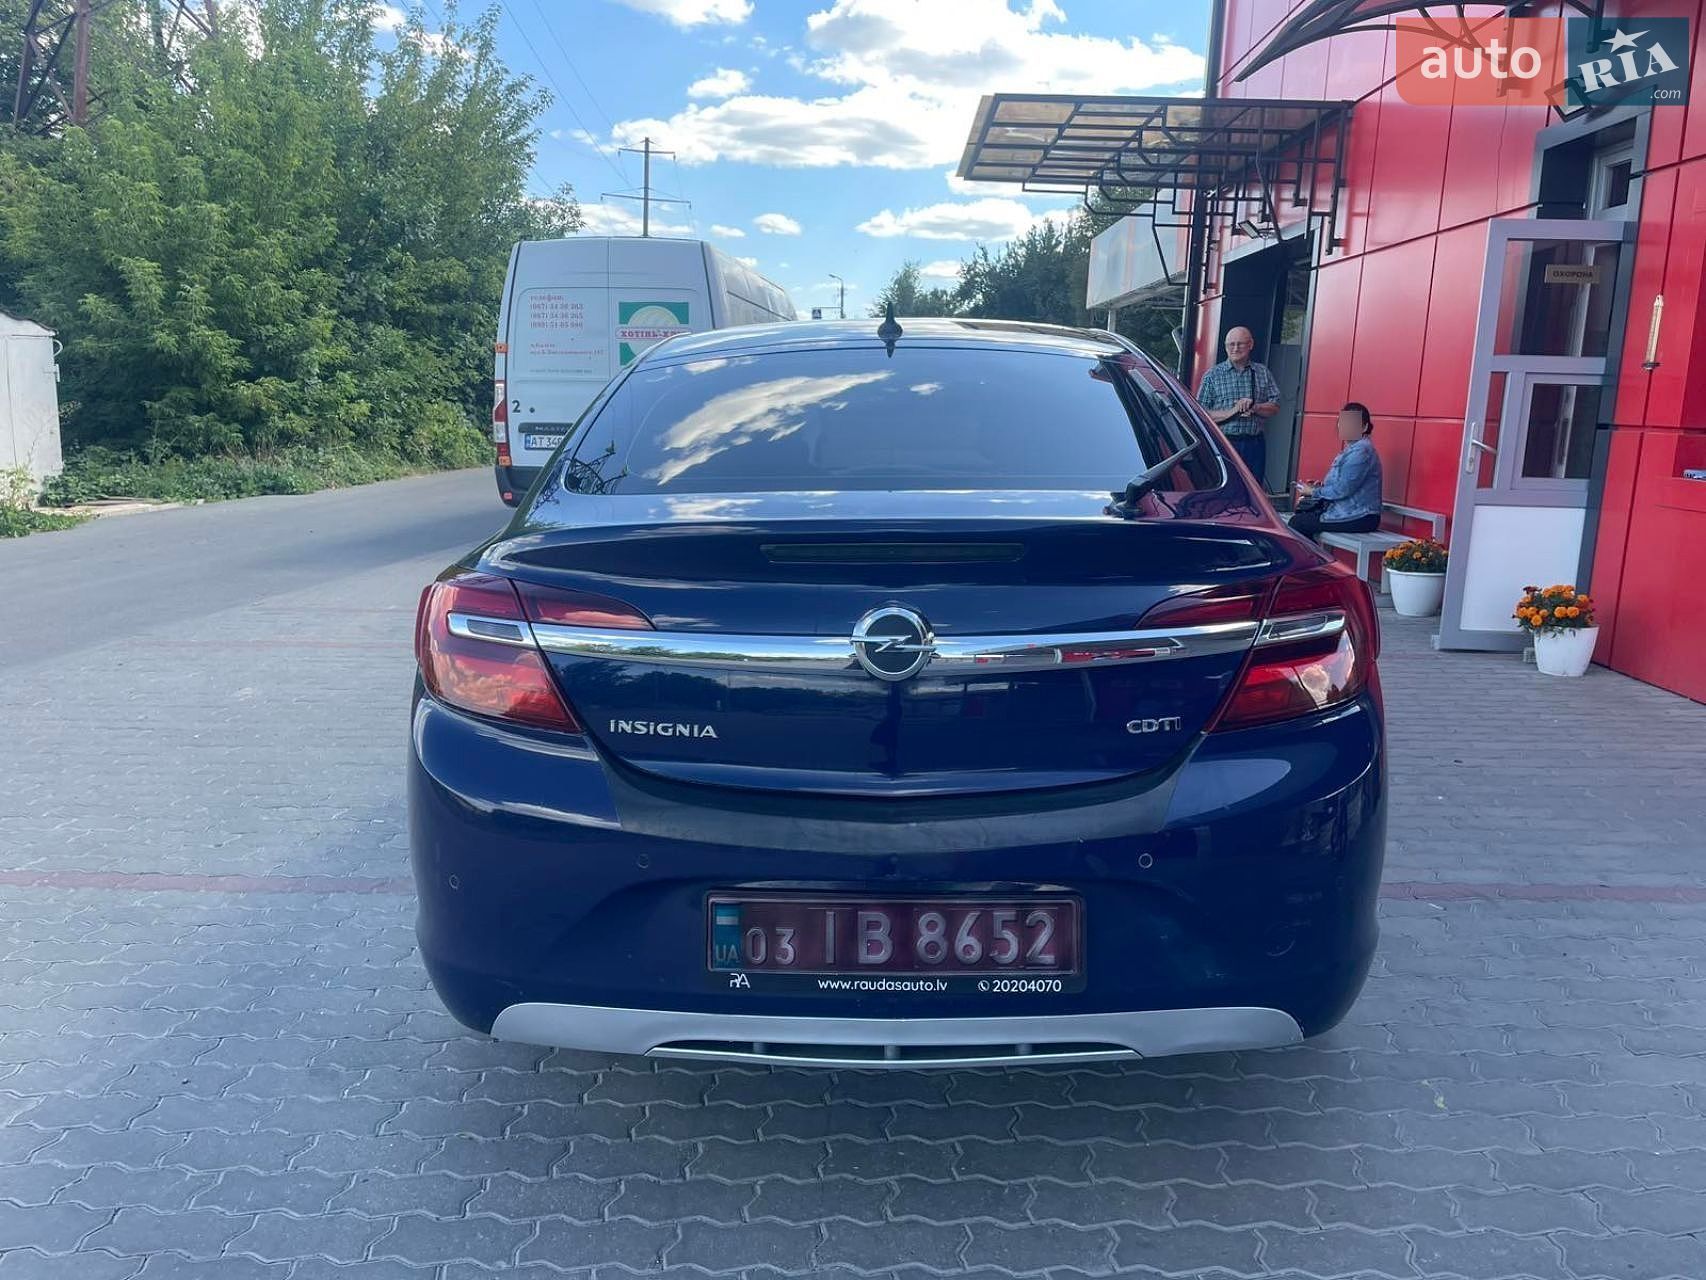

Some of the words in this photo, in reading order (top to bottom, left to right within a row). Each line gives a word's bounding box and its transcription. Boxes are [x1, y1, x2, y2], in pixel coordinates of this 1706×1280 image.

[1553, 270, 1593, 278] ОХОРОНА
[512, 399, 521, 413] 2
[610, 719, 719, 738] INSIGNIA
[1126, 716, 1181, 734] CDTI
[715, 944, 739, 963] UA
[746, 926, 796, 965] 03
[916, 910, 1056, 965] 8652
[818, 978, 948, 992] www.raudasauto.lv
[992, 979, 1062, 993] 20204070
